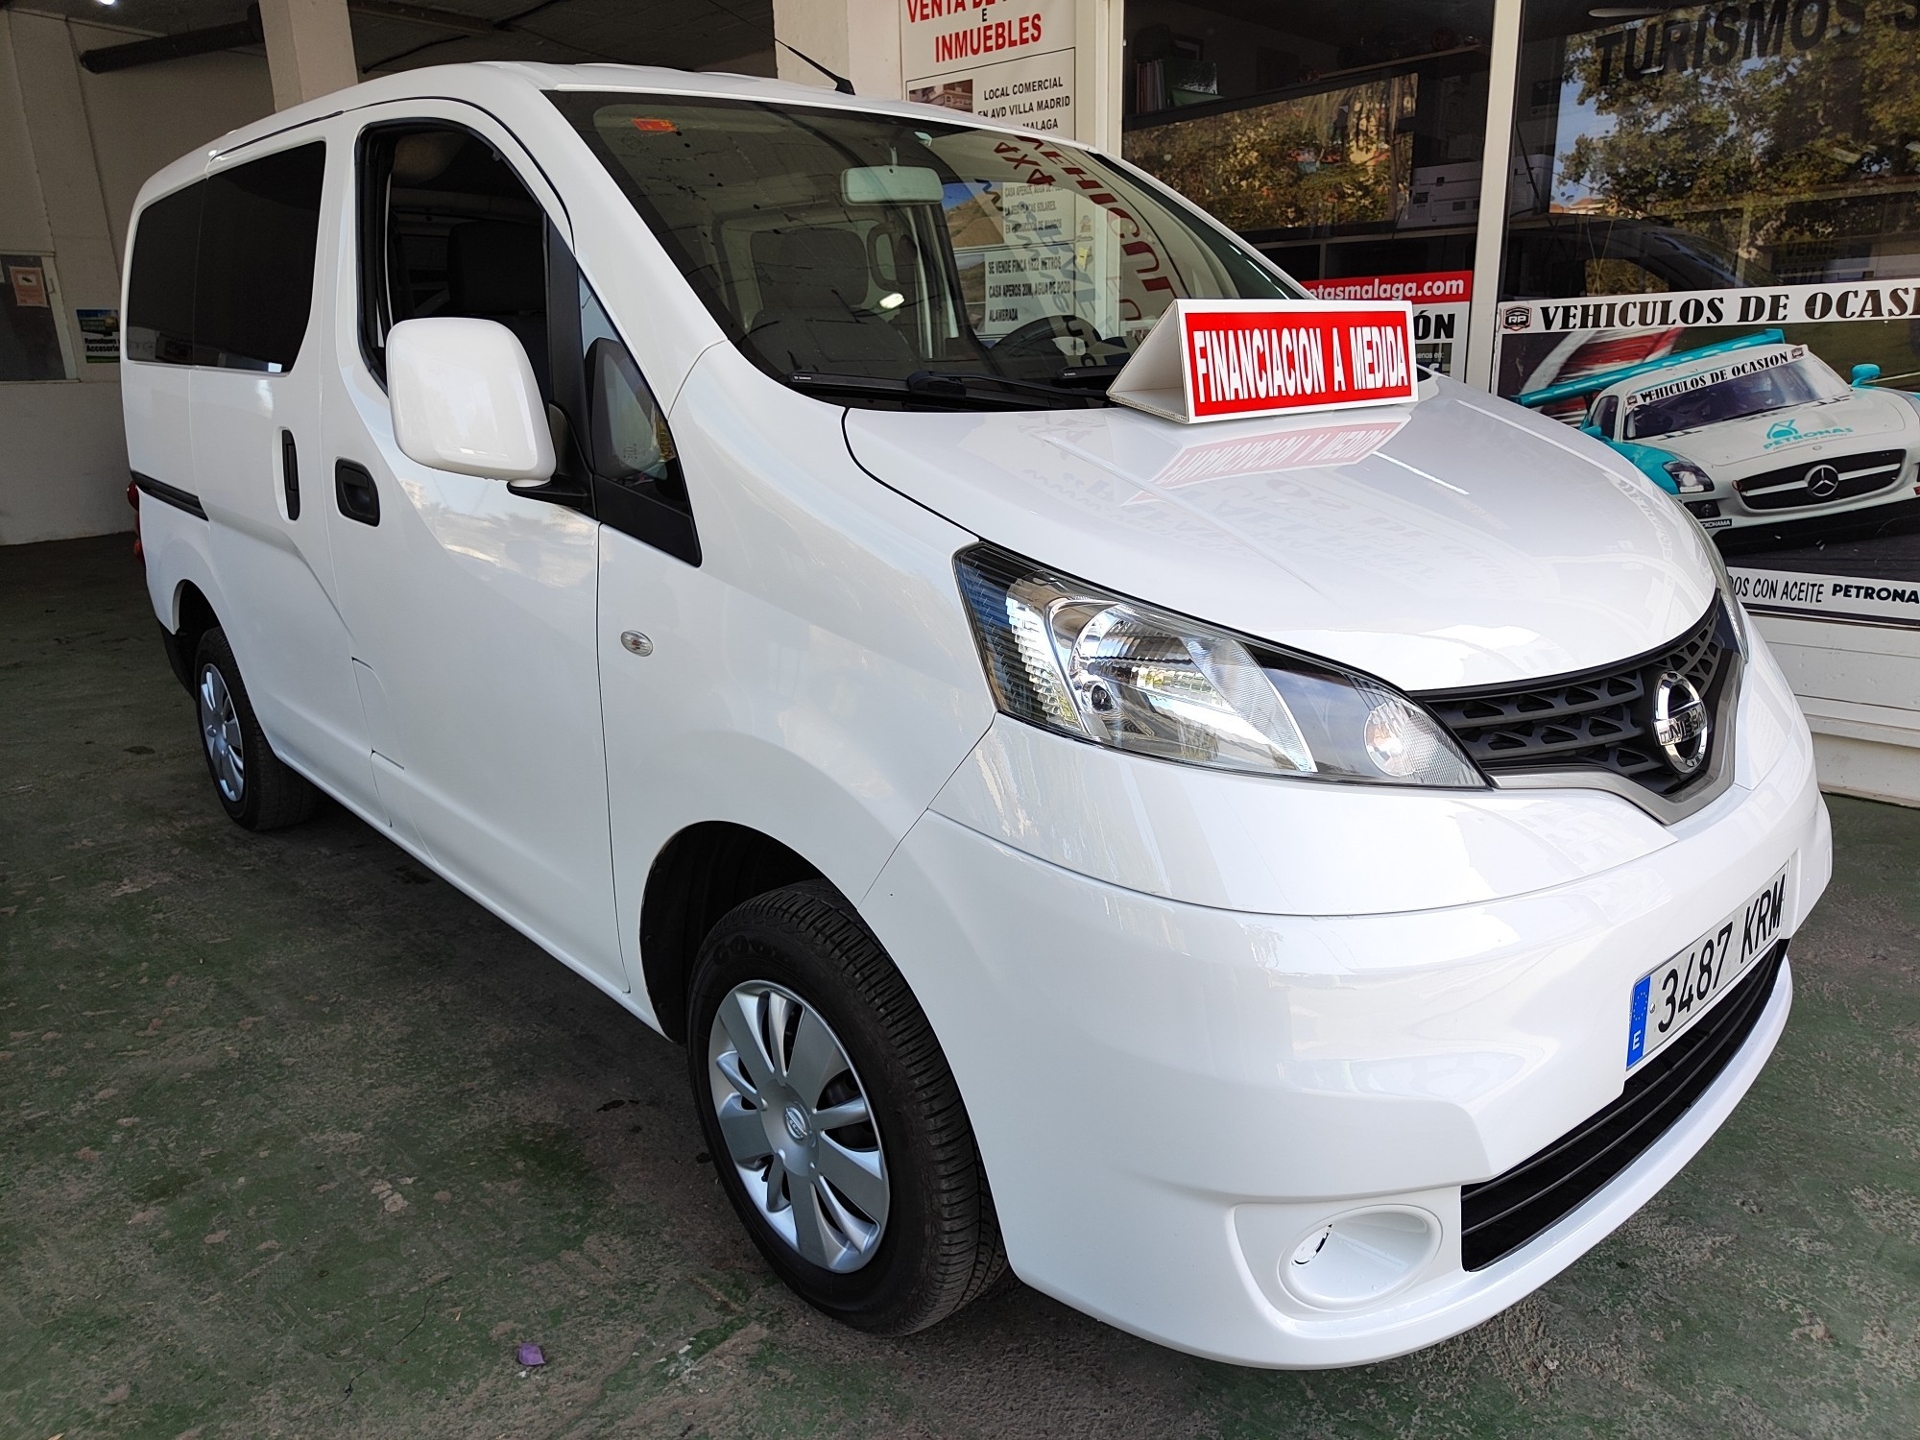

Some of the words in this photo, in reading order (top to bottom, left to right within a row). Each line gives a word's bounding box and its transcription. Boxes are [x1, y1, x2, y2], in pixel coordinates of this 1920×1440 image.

[981, 8, 988, 22] E
[935, 13, 1042, 63] INMUEBLES
[1595, 0, 1865, 86] TURISMOS
[984, 86, 1010, 101] LOCAL
[1012, 76, 1064, 95] COMERCIAL
[991, 106, 1007, 119] AVD
[1009, 102, 1034, 115] VILLA
[1037, 95, 1070, 110] MADRID
[996, 259, 1011, 274] VENDE
[1540, 296, 1724, 331] VEHICULOS
[1738, 294, 1790, 323] DE
[1193, 328, 1326, 403] FINANCIACION
[1332, 327, 1346, 392] A
[1350, 325, 1408, 390] MEDIDA
[1640, 374, 1707, 402] VEHICULOS
[1710, 369, 1728, 384] DE
[1731, 351, 1789, 377] OCASION
[1763, 427, 1854, 450] PETRONAS
[1753, 578, 1779, 600] CON
[1780, 580, 1825, 603] ACEITE
[1657, 921, 1734, 1034] 3487
[1740, 873, 1786, 965] KRM
[1632, 1029, 1642, 1051] E
